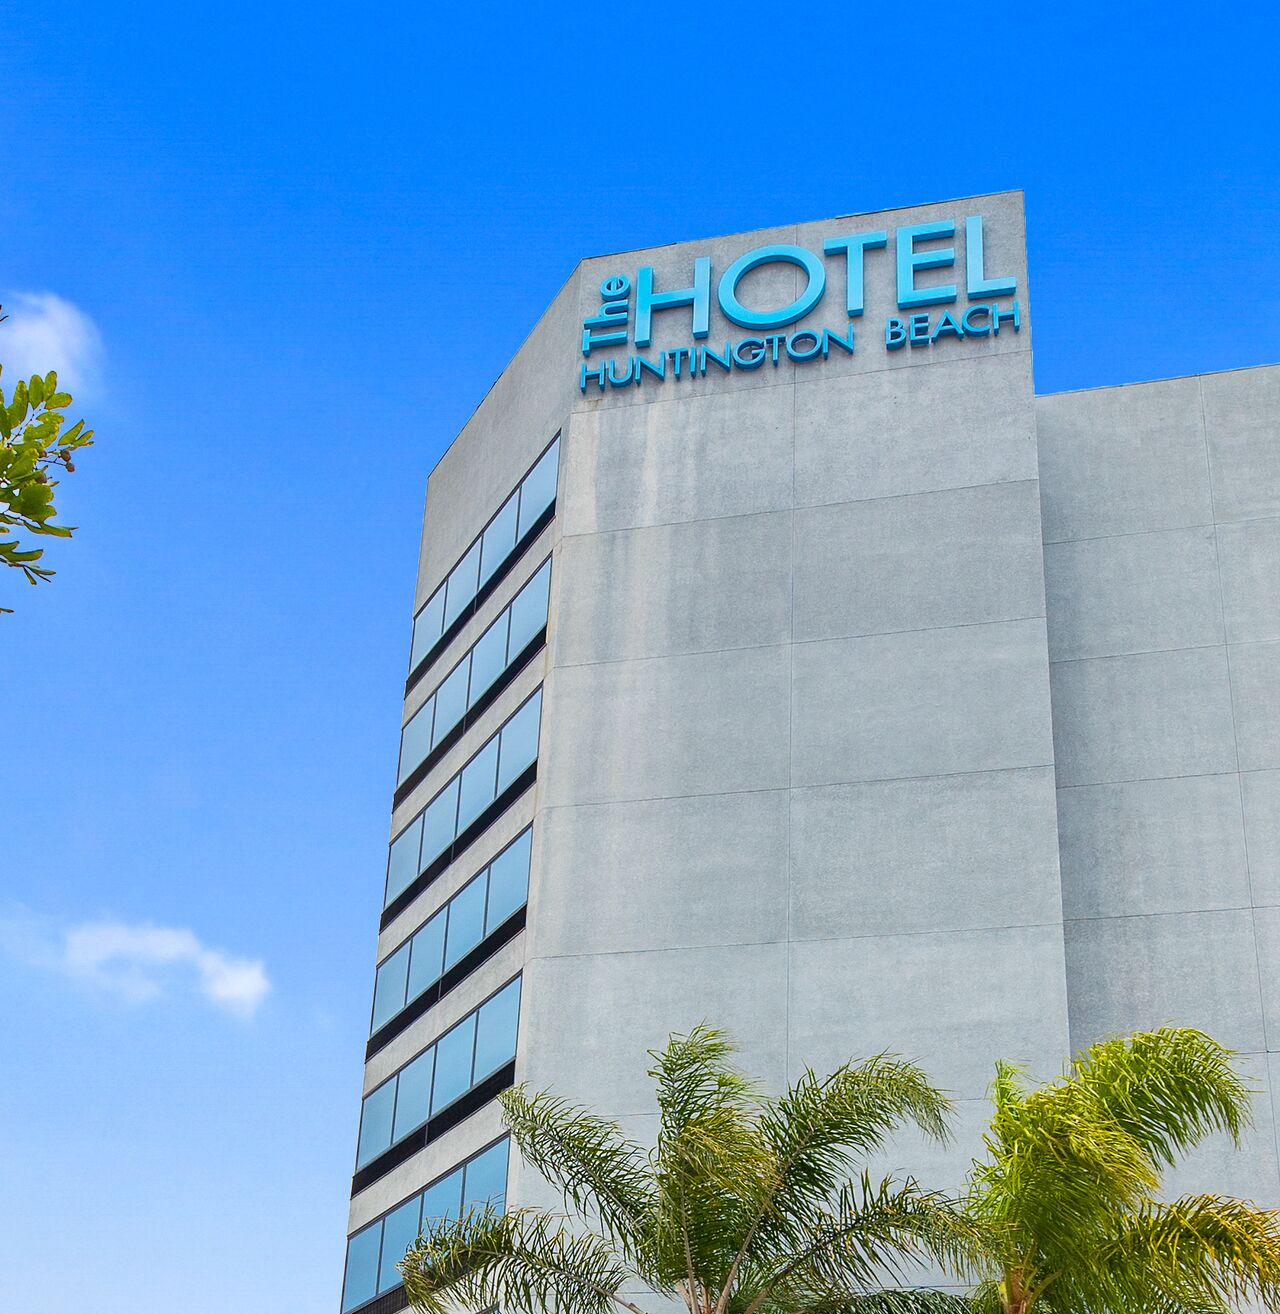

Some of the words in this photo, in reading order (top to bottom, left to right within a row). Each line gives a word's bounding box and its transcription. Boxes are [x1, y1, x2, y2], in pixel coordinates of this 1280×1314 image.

[582, 275, 631, 357] The
[633, 214, 1017, 348] HOTEL
[580, 322, 855, 393] HUNTINGTON
[885, 300, 1021, 350] BEACH
